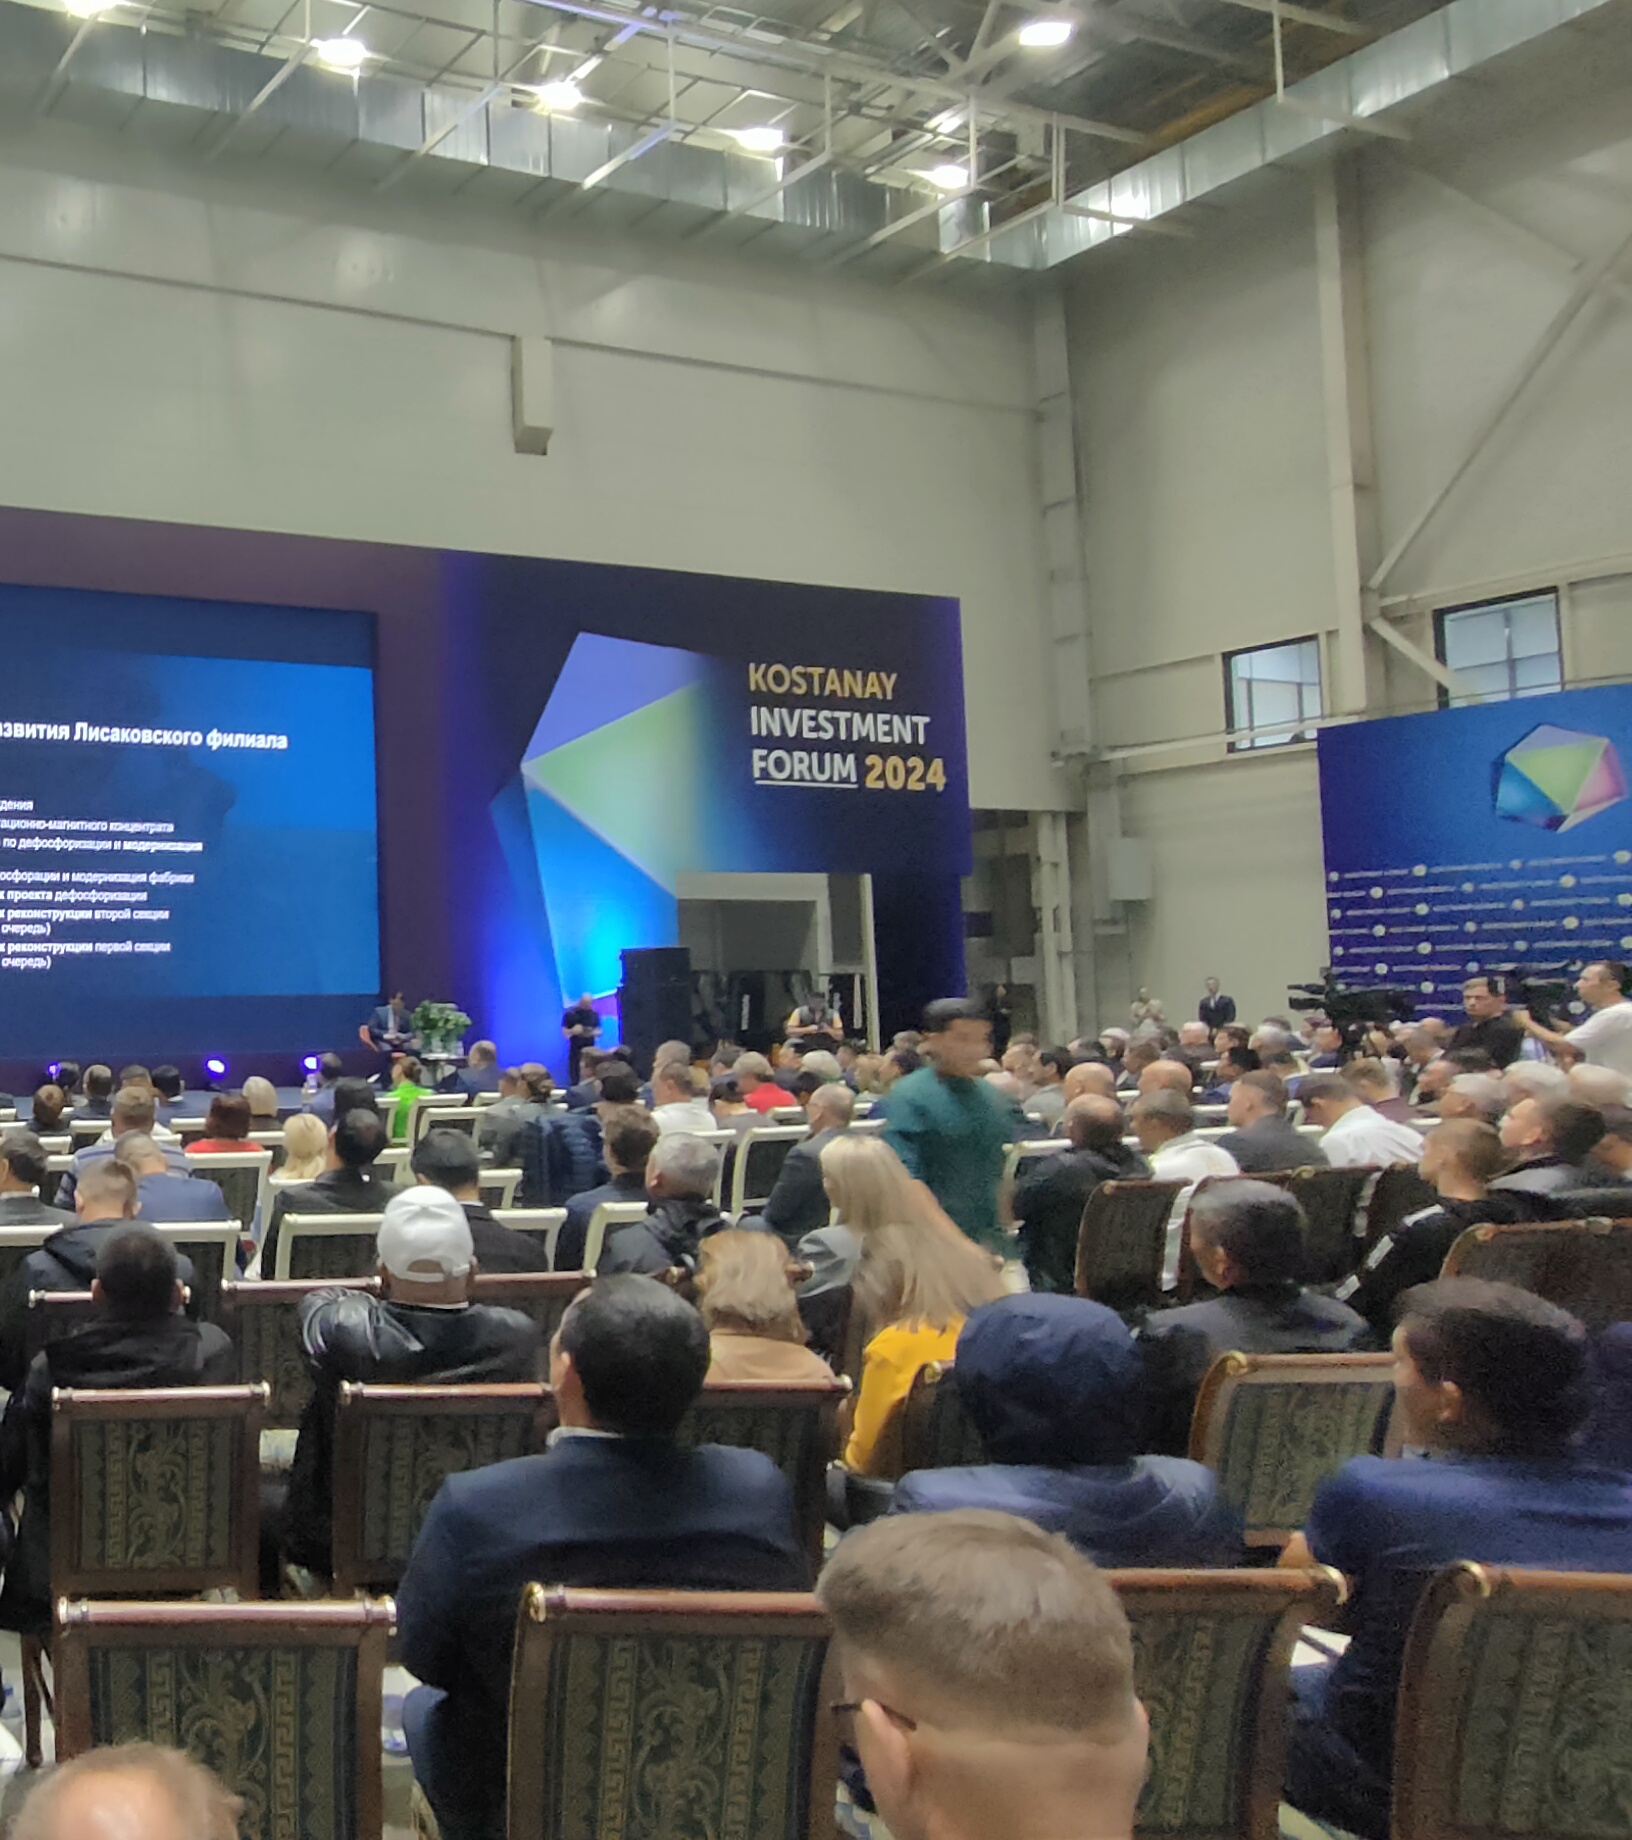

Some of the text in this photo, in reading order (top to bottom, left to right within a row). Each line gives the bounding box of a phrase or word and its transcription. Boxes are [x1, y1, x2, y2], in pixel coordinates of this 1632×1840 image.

[748, 662, 897, 700] KOSTANAY
[750, 705, 931, 745] INVESTMENT
[74, 722, 203, 746] Лисаковского
[206, 728, 288, 750] филиала
[752, 748, 946, 792] FORUM 2024
[3, 837, 17, 848] по
[113, 840, 121, 850] и
[62, 872, 70, 882] и
[6, 890, 53, 903] проекта
[94, 908, 131, 921] второй
[1, 922, 52, 936] очередь)
[1, 956, 52, 970] очередь)
